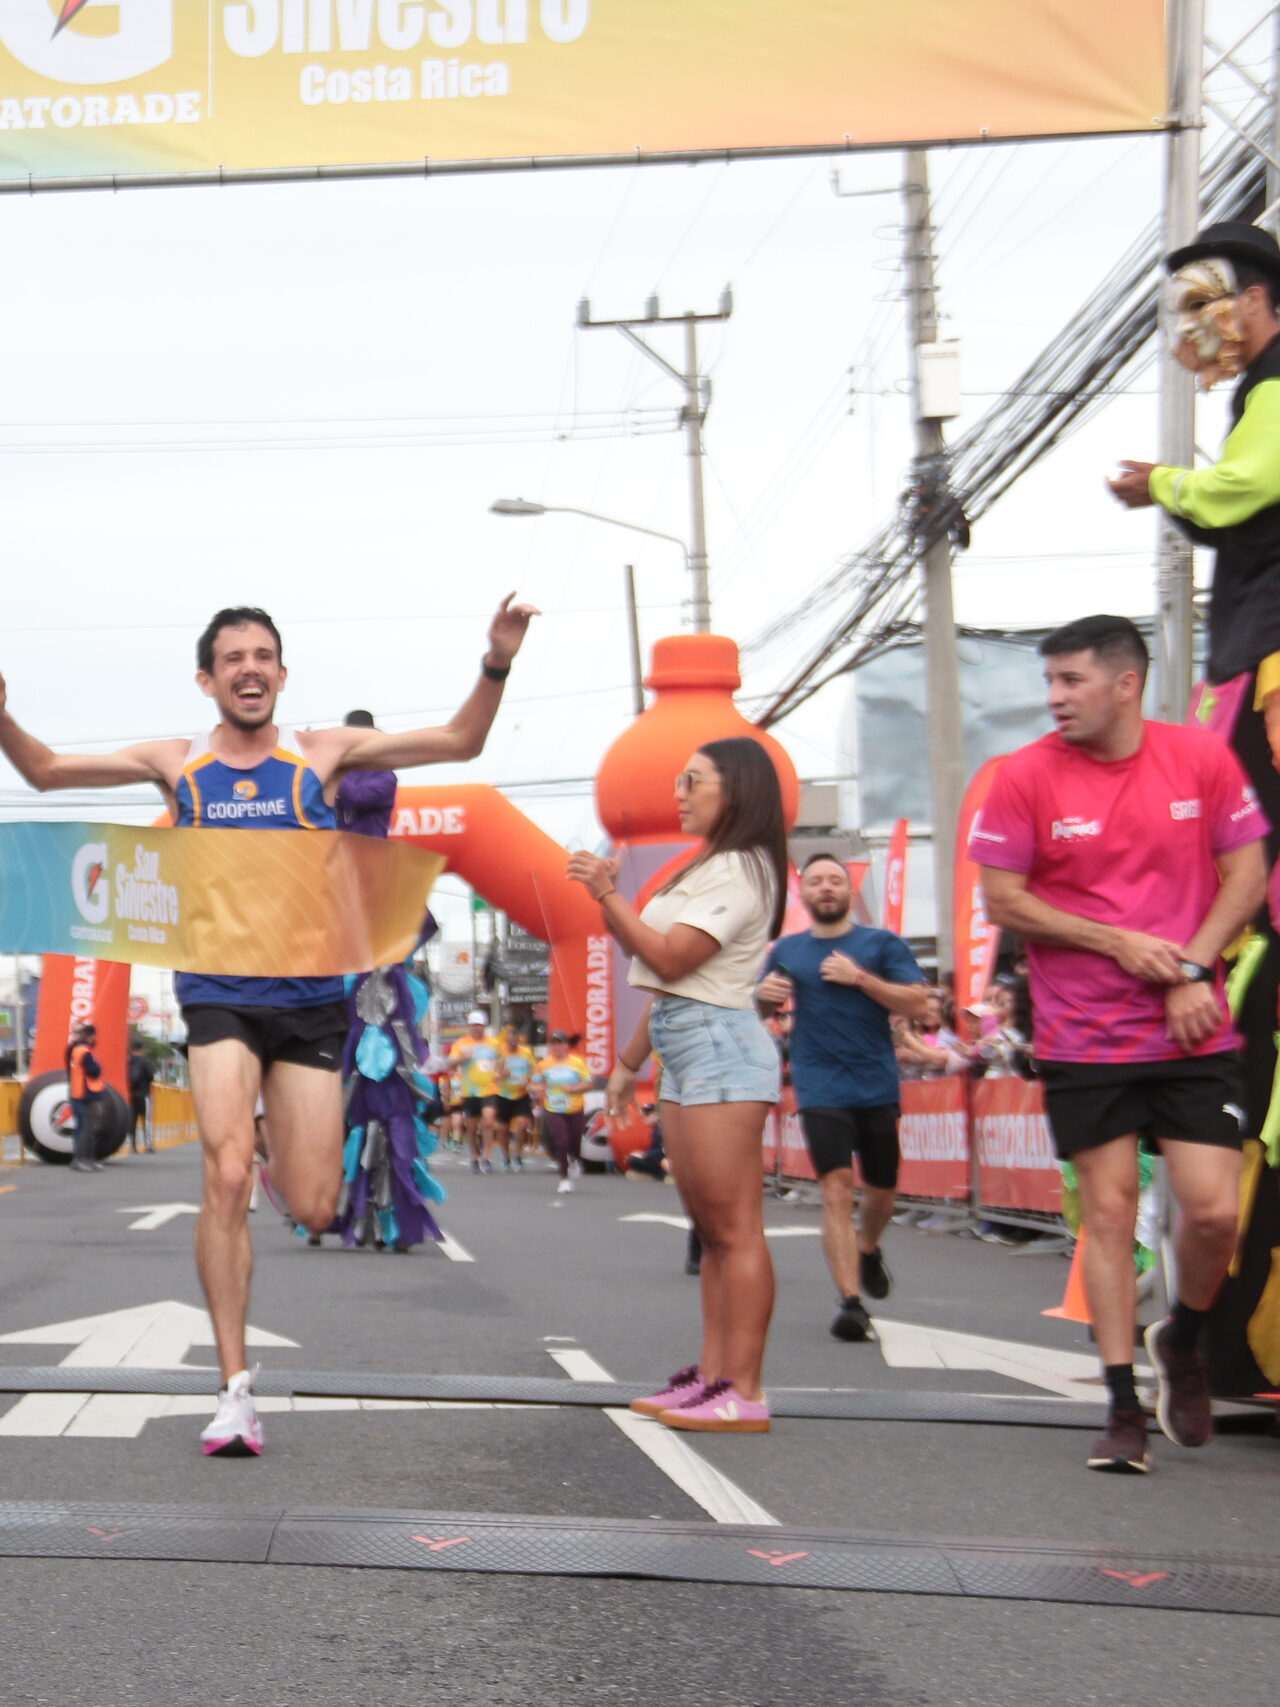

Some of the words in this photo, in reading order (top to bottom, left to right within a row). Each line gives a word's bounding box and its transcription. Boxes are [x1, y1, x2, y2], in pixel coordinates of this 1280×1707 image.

[299, 65, 411, 106] Costa
[421, 58, 509, 100] Rica
[207, 799, 287, 820] COOPENAE
[388, 806, 465, 836] ADE
[115, 862, 179, 926] Silvestre
[586, 936, 609, 1075] GATORADE
